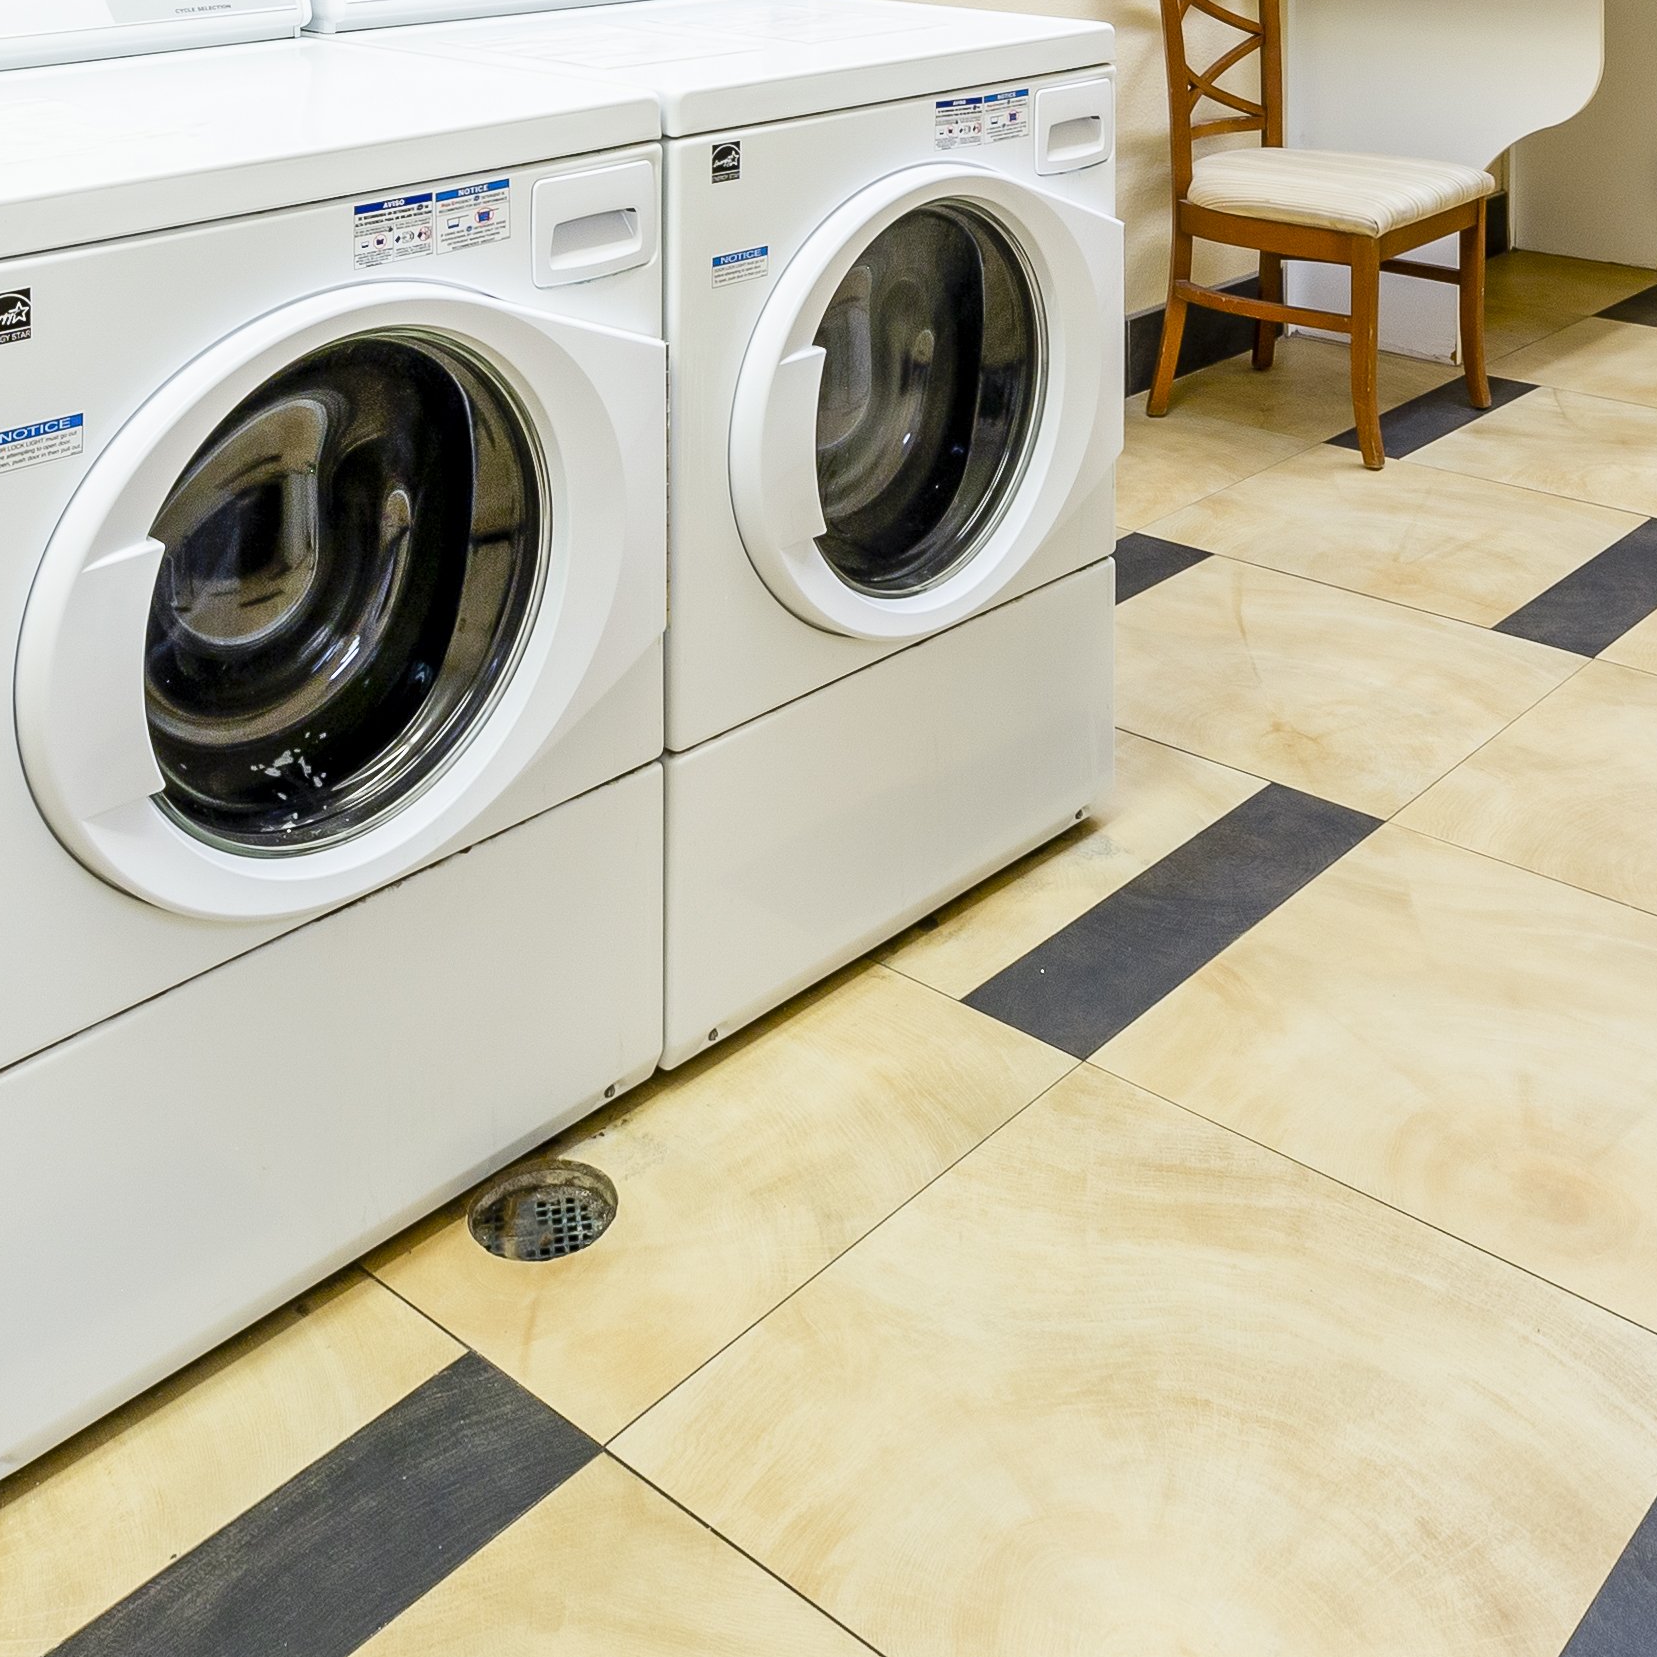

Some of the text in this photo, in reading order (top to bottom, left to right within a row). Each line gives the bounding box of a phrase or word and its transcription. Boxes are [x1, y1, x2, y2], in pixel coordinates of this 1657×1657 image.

[458, 184, 488, 196] NOTICE
[720, 248, 762, 264] NOTICE
[12, 330, 30, 340] STAR
[0, 418, 70, 444] NOTICE
[8, 444, 24, 452] LOCK
[26, 438, 44, 447] LIGHT
